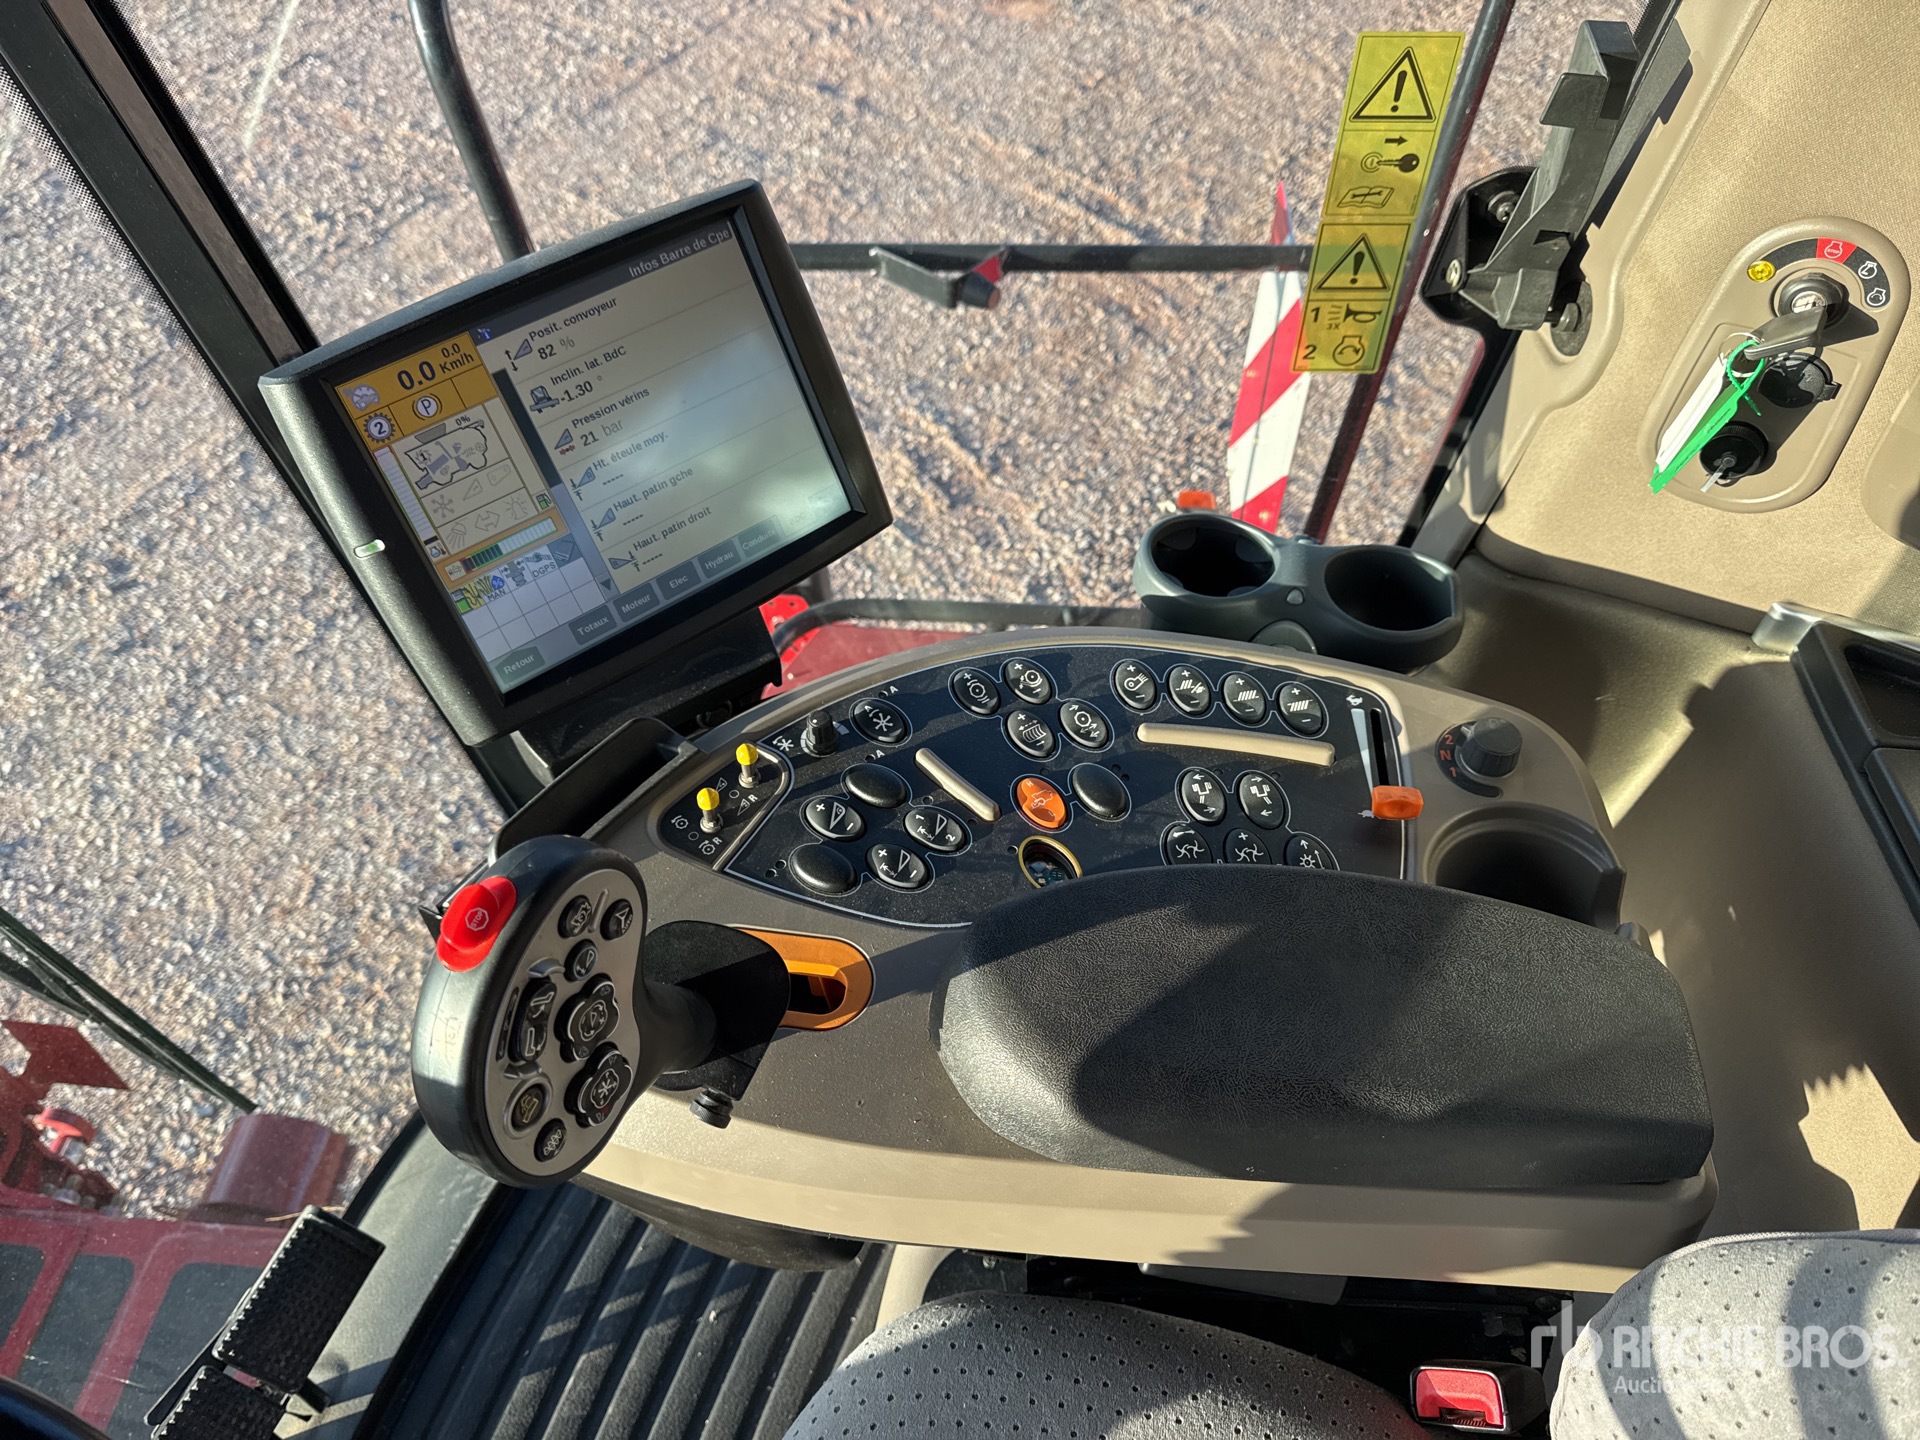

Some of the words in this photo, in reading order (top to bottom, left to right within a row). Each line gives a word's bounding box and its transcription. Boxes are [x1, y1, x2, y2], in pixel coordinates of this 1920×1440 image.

[629, 259, 659, 277] Infos
[659, 245, 692, 265] Barre
[693, 238, 707, 251] de
[708, 229, 730, 245] Cpe
[529, 321, 562, 341] Posit.
[563, 297, 618, 327] convoyeur
[1311, 307, 1320, 323] 1
[441, 343, 461, 358] 0.0
[538, 344, 557, 360] 82
[560, 336, 575, 350] %
[1302, 344, 1317, 360] 2
[397, 361, 436, 390] 0.0
[439, 352, 474, 374] Km/h
[550, 365, 584, 386] Inclin.
[585, 356, 603, 372] lat.
[603, 346, 627, 364] BdC
[560, 380, 594, 402] -1.30
[420, 398, 431, 415] P
[572, 402, 618, 429] Pression
[619, 387, 650, 407] vérins
[374, 421, 386, 436] 2
[455, 415, 471, 426] 0%
[580, 431, 599, 447] 21
[601, 419, 624, 437] bar
[592, 458, 609, 472] Ht.
[611, 442, 642, 464] éteule
[643, 431, 669, 449] moy.
[613, 493, 642, 512] Haut.
[641, 480, 669, 500] patin
[669, 467, 693, 488] gche
[633, 533, 661, 552] Haut.
[661, 520, 687, 540] patin
[687, 506, 712, 525] droit
[532, 561, 557, 578] DGPS
[705, 551, 734, 571] Hydrau
[669, 575, 689, 590] Elec
[487, 588, 506, 602] MAN
[621, 594, 651, 614] Moteur
[577, 616, 609, 636] Totaux
[503, 653, 535, 675] Retour
[889, 685, 899, 694] A
[1444, 734, 1454, 745] 2
[875, 749, 885, 758] A
[1440, 750, 1451, 761] N
[1449, 767, 1457, 778] 1
[748, 794, 758, 802] R
[712, 836, 723, 845] R
[945, 834, 956, 842] 2
[470, 910, 484, 929] STOP
